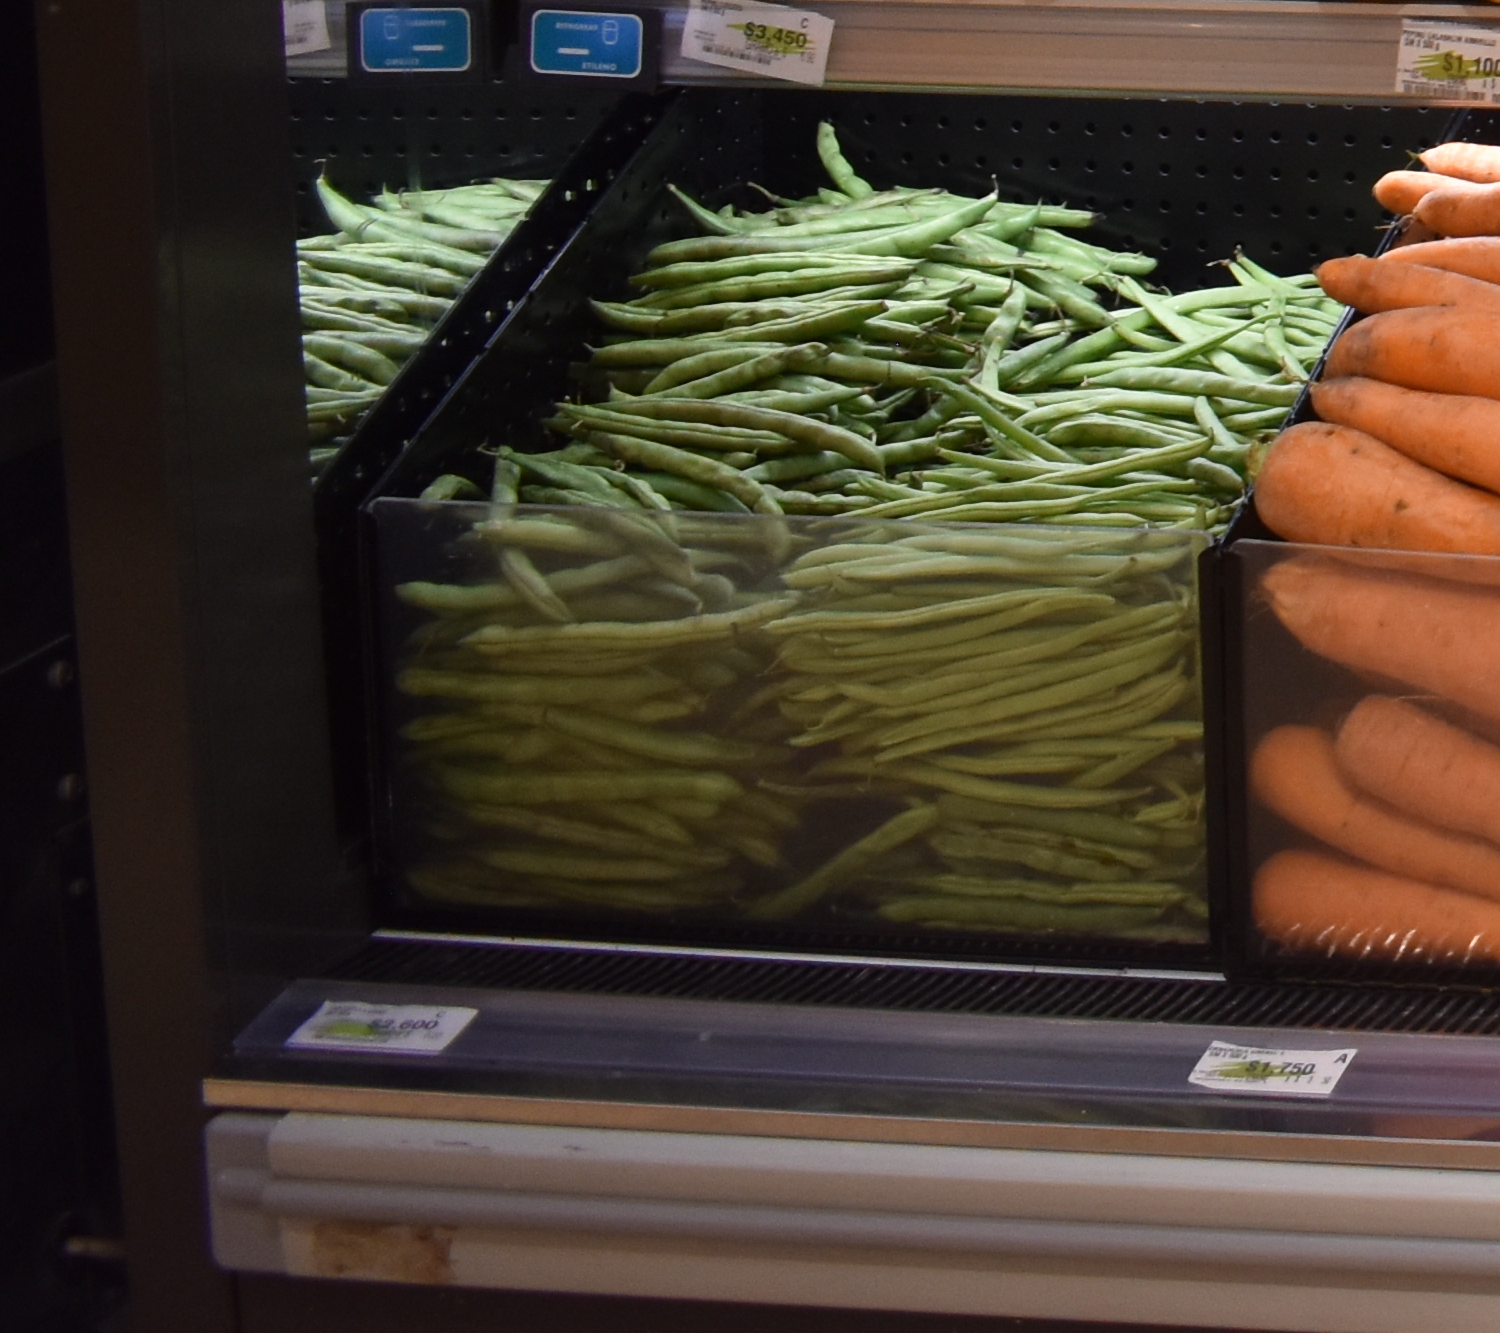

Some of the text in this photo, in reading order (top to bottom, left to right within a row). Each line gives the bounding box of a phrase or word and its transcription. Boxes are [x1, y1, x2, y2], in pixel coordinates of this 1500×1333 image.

[801, 19, 808, 29] C
[743, 22, 807, 49] $3,450
[582, 62, 616, 71] ETILENO
[1334, 1054, 1347, 1064] A
[1248, 1060, 1315, 1075] $1,750
